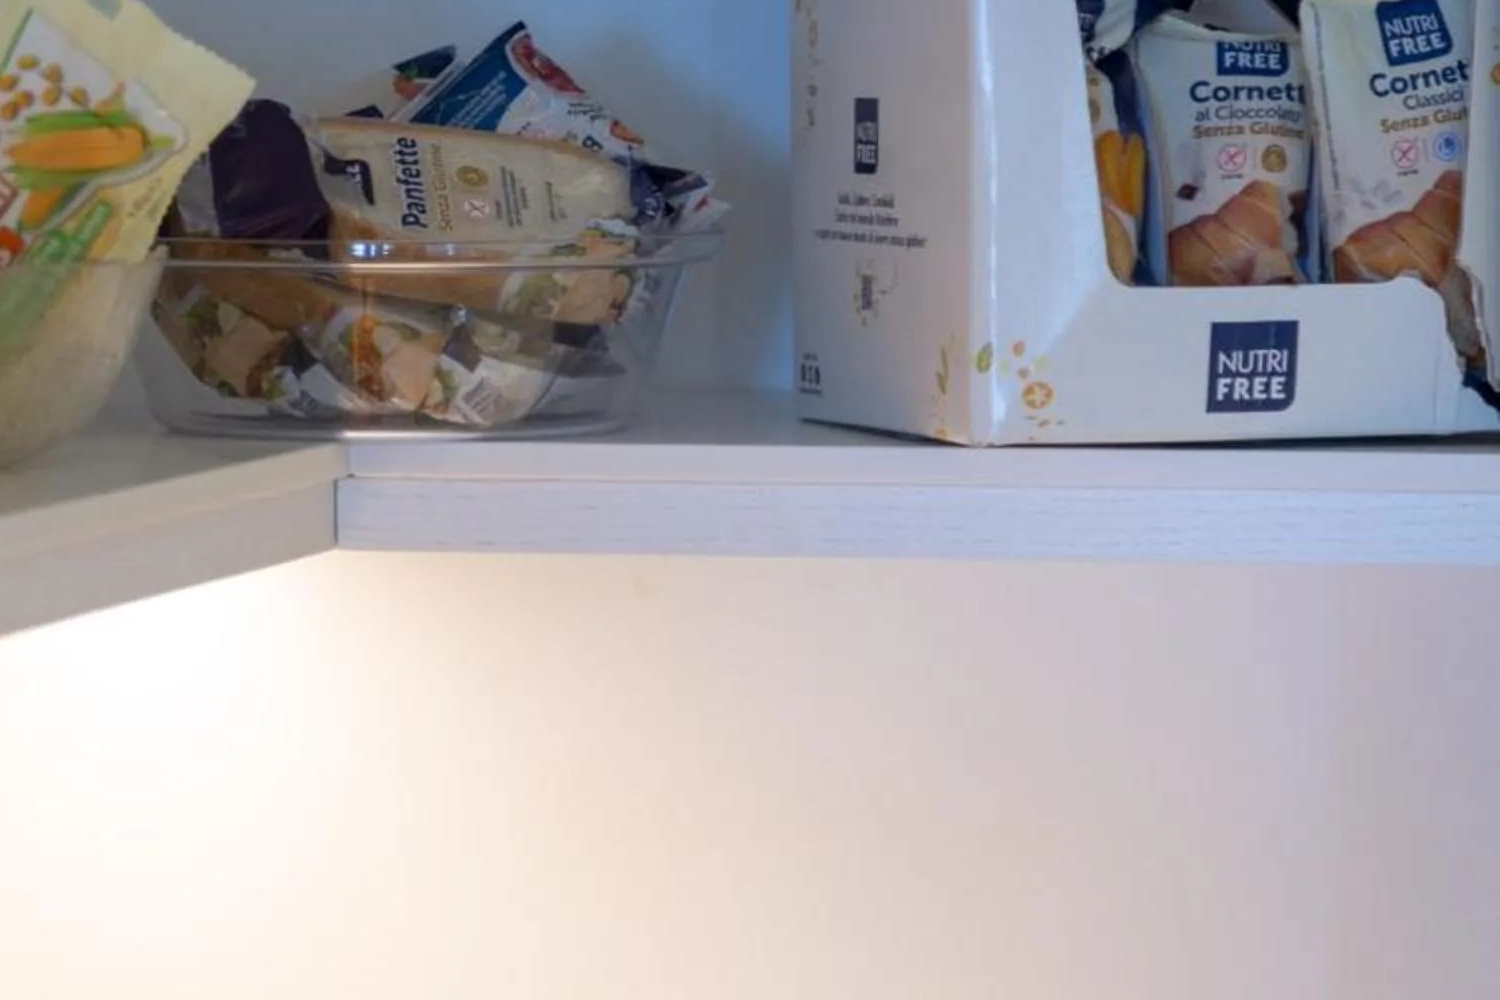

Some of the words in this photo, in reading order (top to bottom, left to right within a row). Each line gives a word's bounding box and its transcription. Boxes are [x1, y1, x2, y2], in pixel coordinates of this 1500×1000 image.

[1383, 12, 1440, 38] NUTRI
[1387, 32, 1446, 58] FREE
[1224, 51, 1282, 69] FREE
[1403, 86, 1464, 111] Classici
[1194, 107, 1212, 122] al
[1380, 116, 1430, 134] Senza
[1192, 123, 1246, 139] Senza
[393, 137, 428, 229] Panfette
[1218, 348, 1288, 374] NUTRI
[1216, 376, 1286, 401] FREE
